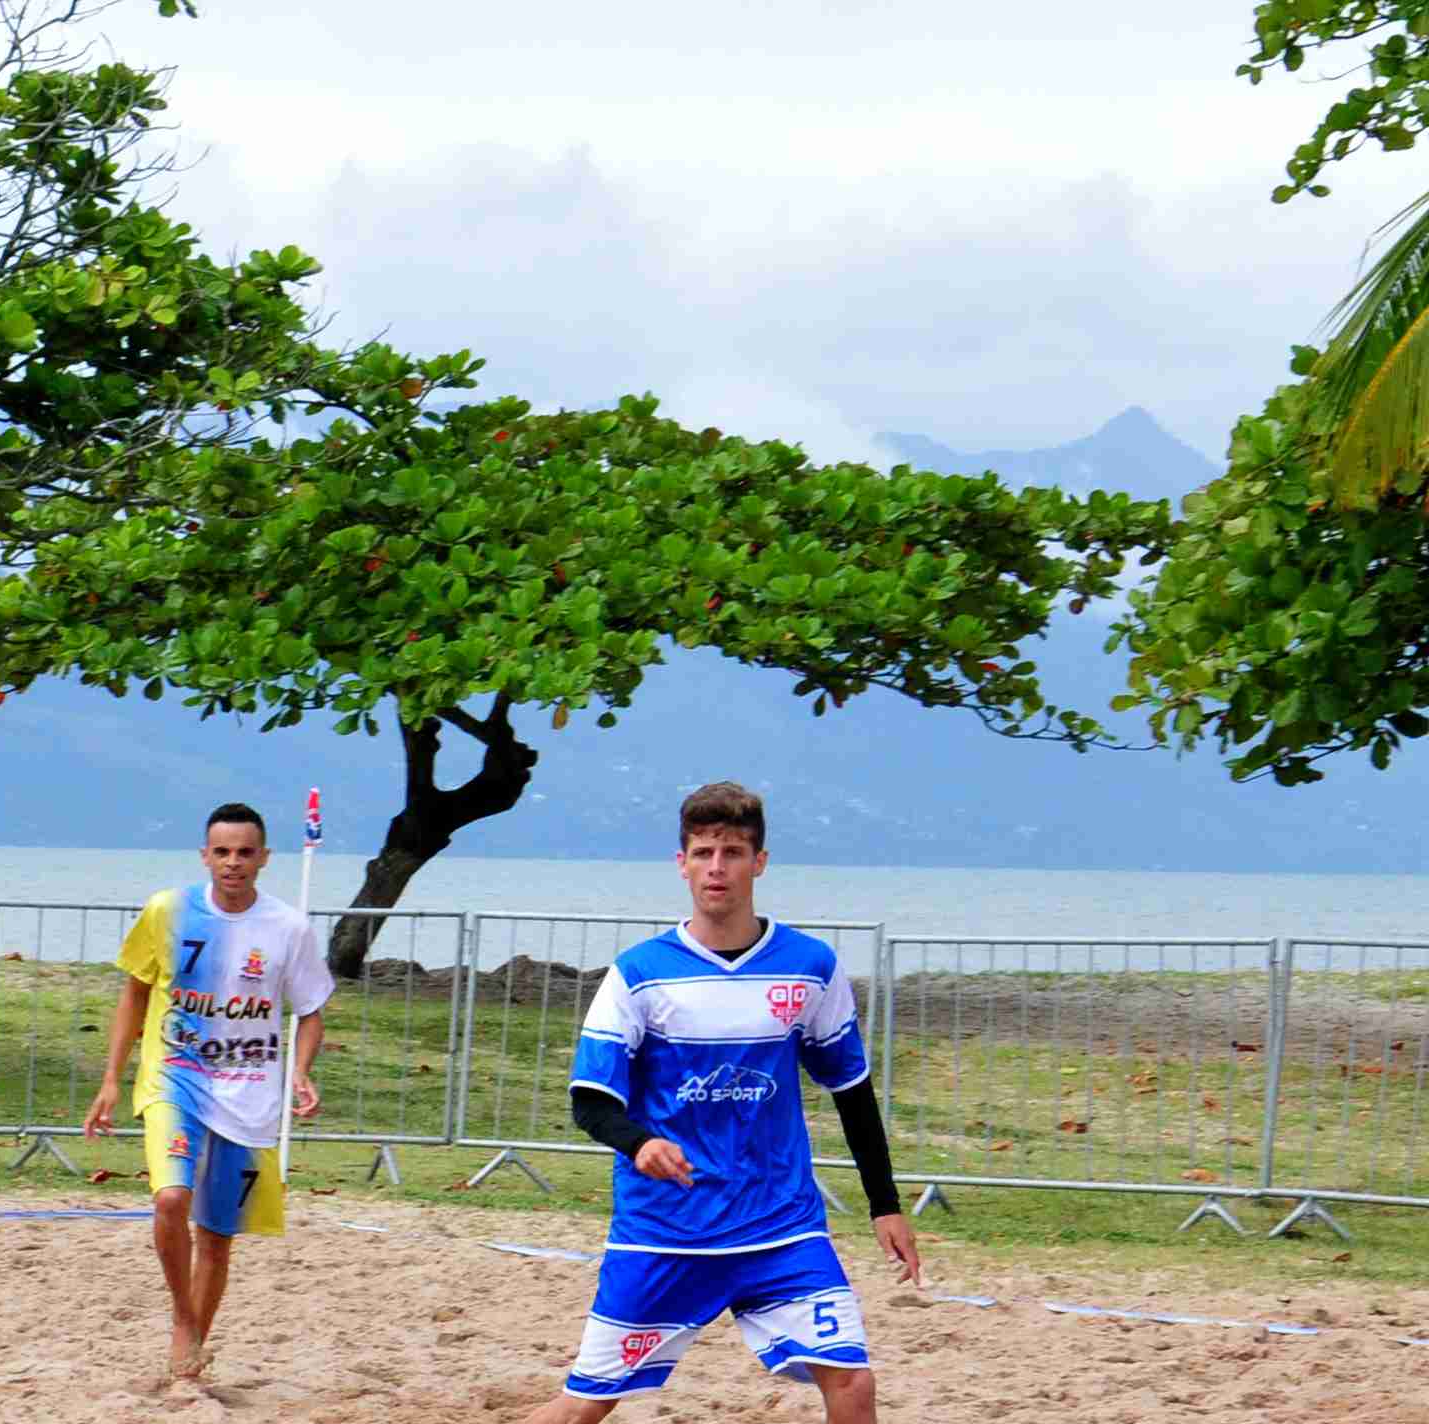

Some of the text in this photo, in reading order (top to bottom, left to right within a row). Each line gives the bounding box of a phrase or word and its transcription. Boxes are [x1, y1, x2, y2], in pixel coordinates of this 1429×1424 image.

[181, 939, 206, 975] 7
[238, 1169, 260, 1208] 7
[813, 1301, 839, 1338] 5
